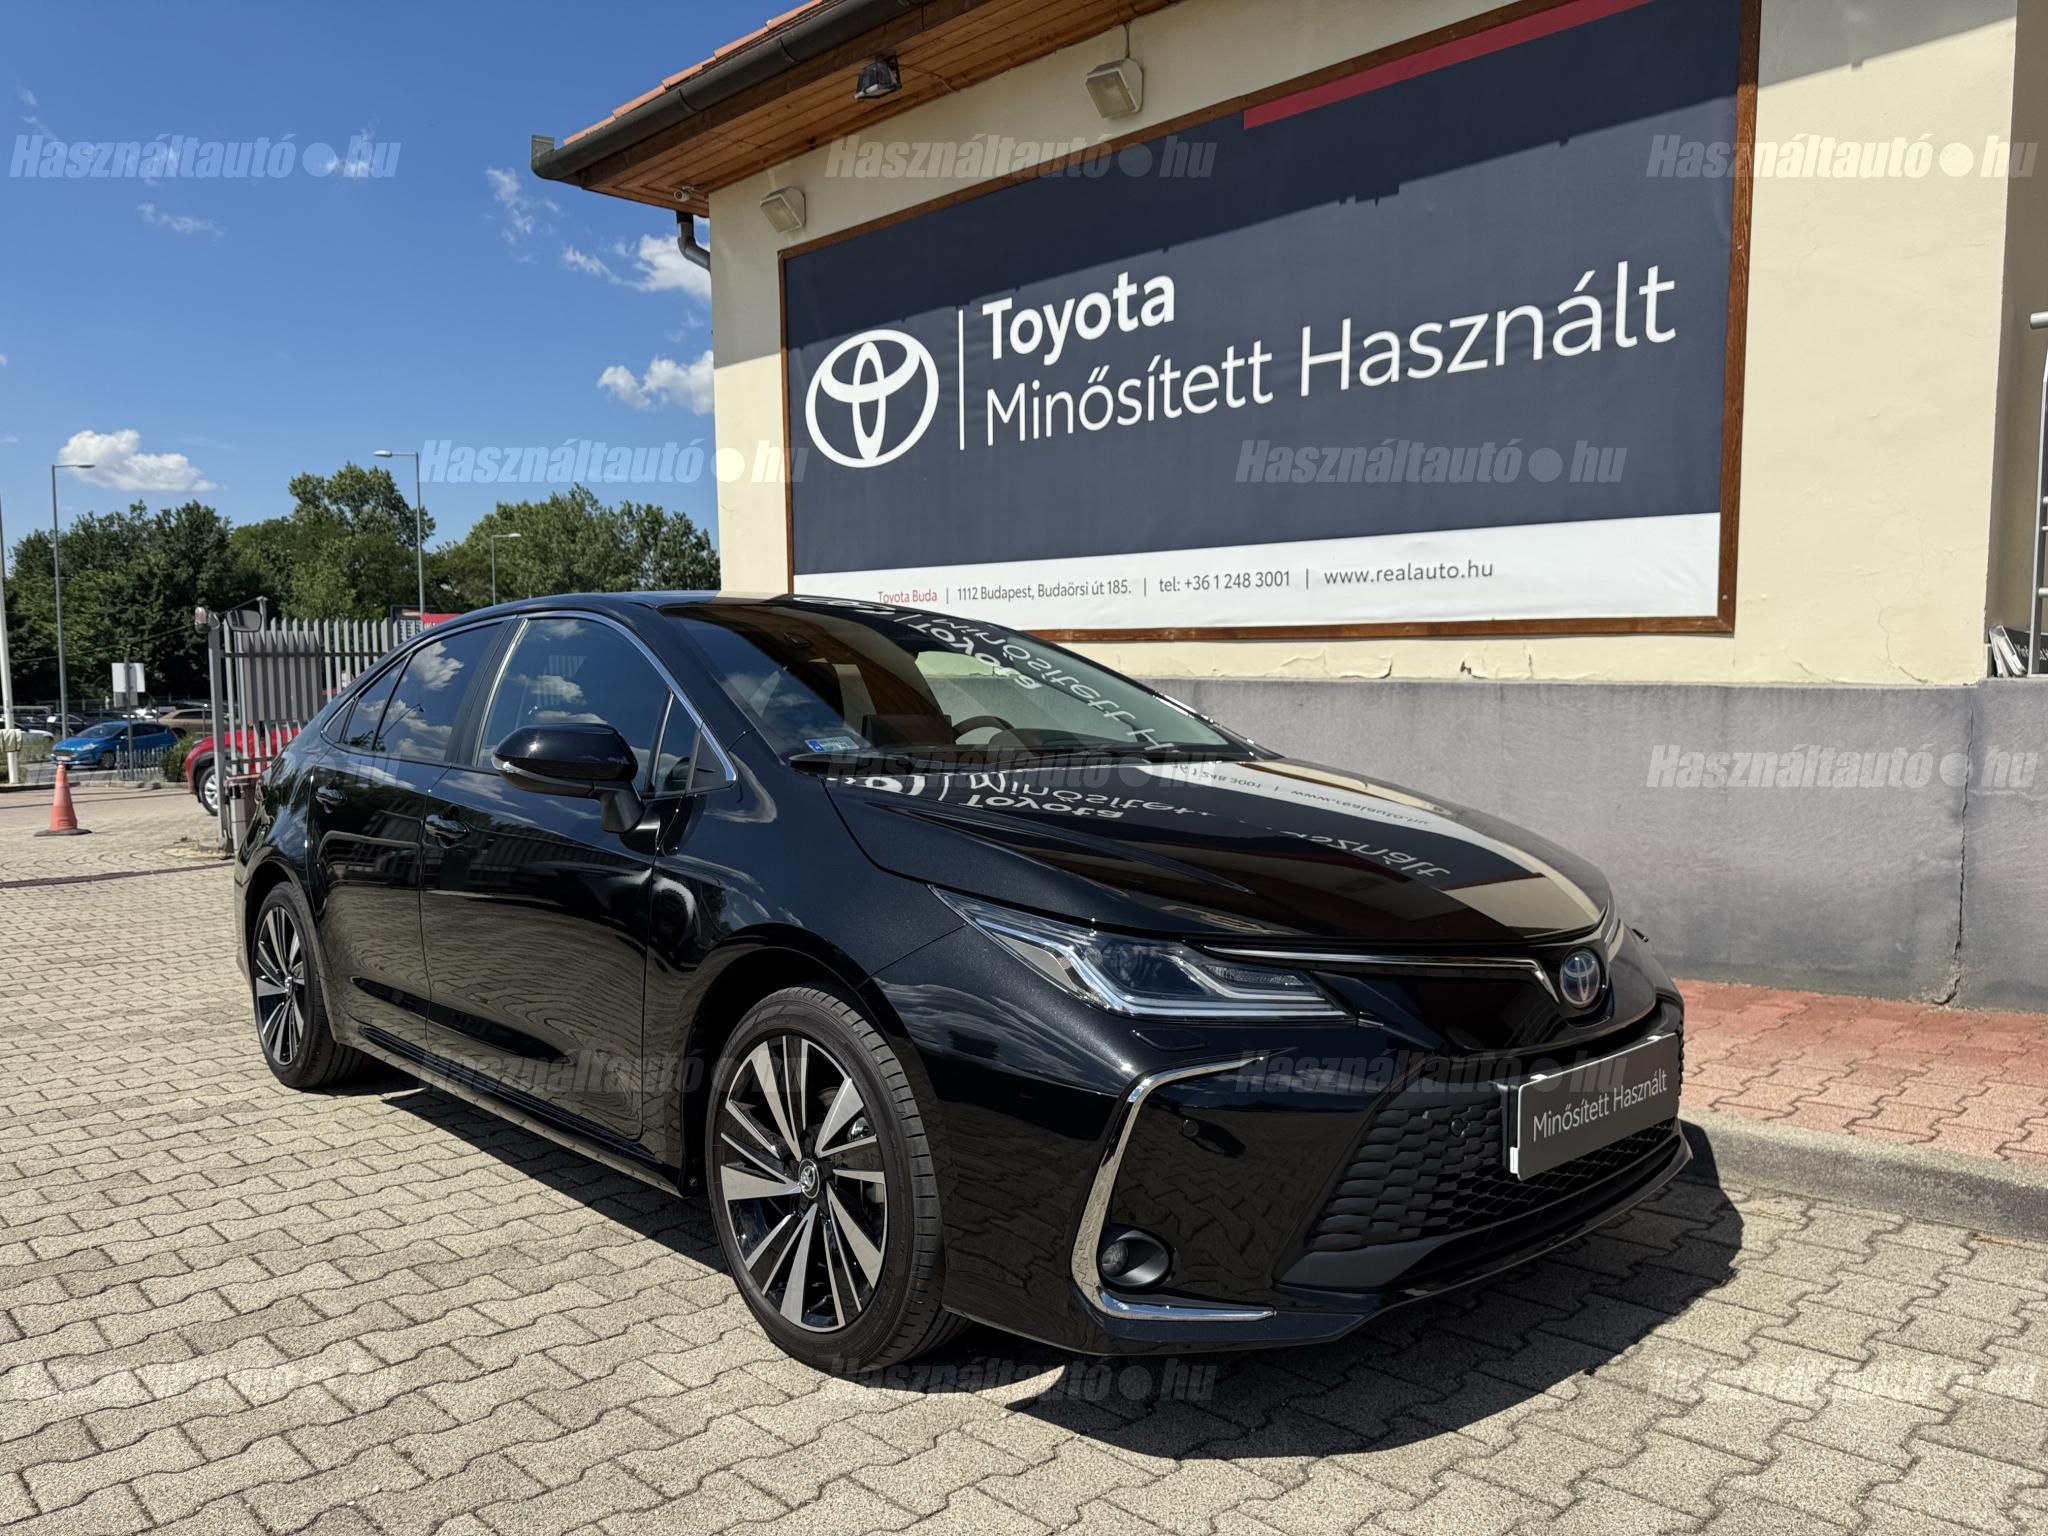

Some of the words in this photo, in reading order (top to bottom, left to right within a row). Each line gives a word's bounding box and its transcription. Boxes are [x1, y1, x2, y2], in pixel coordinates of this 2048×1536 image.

[982, 271, 1175, 366] Toyota
[987, 340, 1274, 447] Minősített
[1300, 261, 1676, 397] Használt
[877, 591, 910, 604] Toyota
[912, 590, 937, 603] Buda
[957, 587, 978, 601] 1112
[981, 584, 1035, 602] Budapest,
[1037, 580, 1089, 598] Budaörsi
[1091, 578, 1104, 595] út
[1107, 579, 1132, 595] 185.
[1159, 575, 1181, 592] tel:
[1184, 574, 1210, 591] +36
[1224, 572, 1251, 589] 248
[1255, 570, 1291, 588] 3001
[1324, 559, 1494, 585] www.realauto.hu
[1533, 1098, 1610, 1143] Minősített
[1613, 1068, 1668, 1113] Használt
